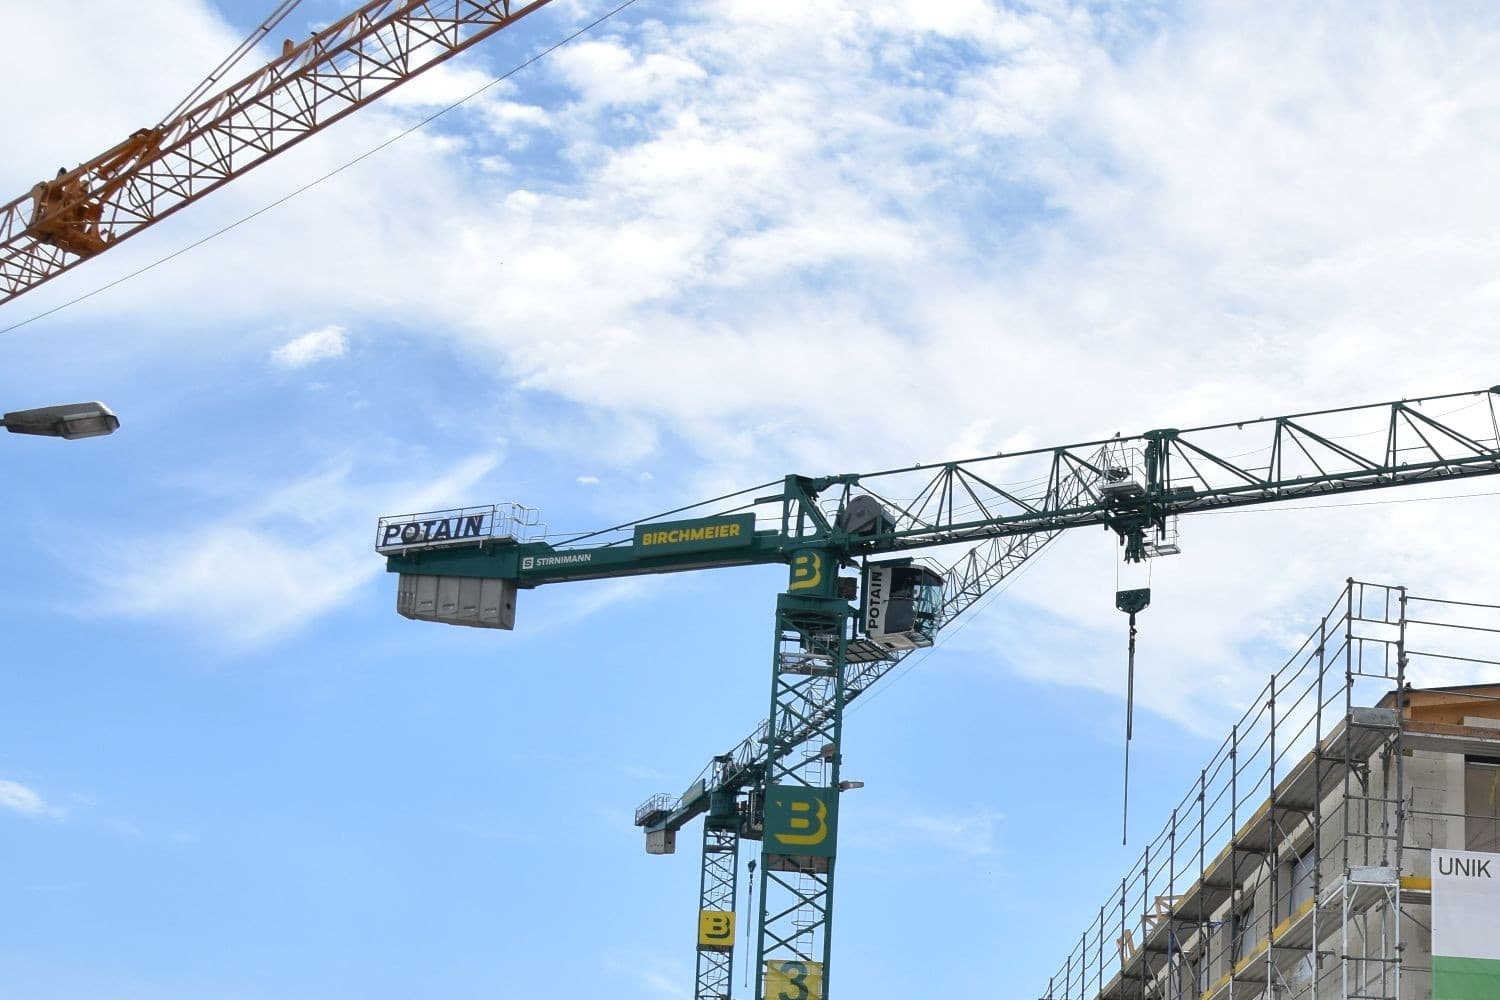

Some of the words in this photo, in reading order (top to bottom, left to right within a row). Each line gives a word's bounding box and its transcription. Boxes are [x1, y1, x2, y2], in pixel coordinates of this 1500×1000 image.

[383, 514, 485, 546] POTAIN
[642, 523, 741, 546] BIRCHMEIER
[536, 553, 592, 567] STIRNIMANN
[868, 571, 883, 629] POTAIN
[1439, 857, 1491, 878] UNIK
